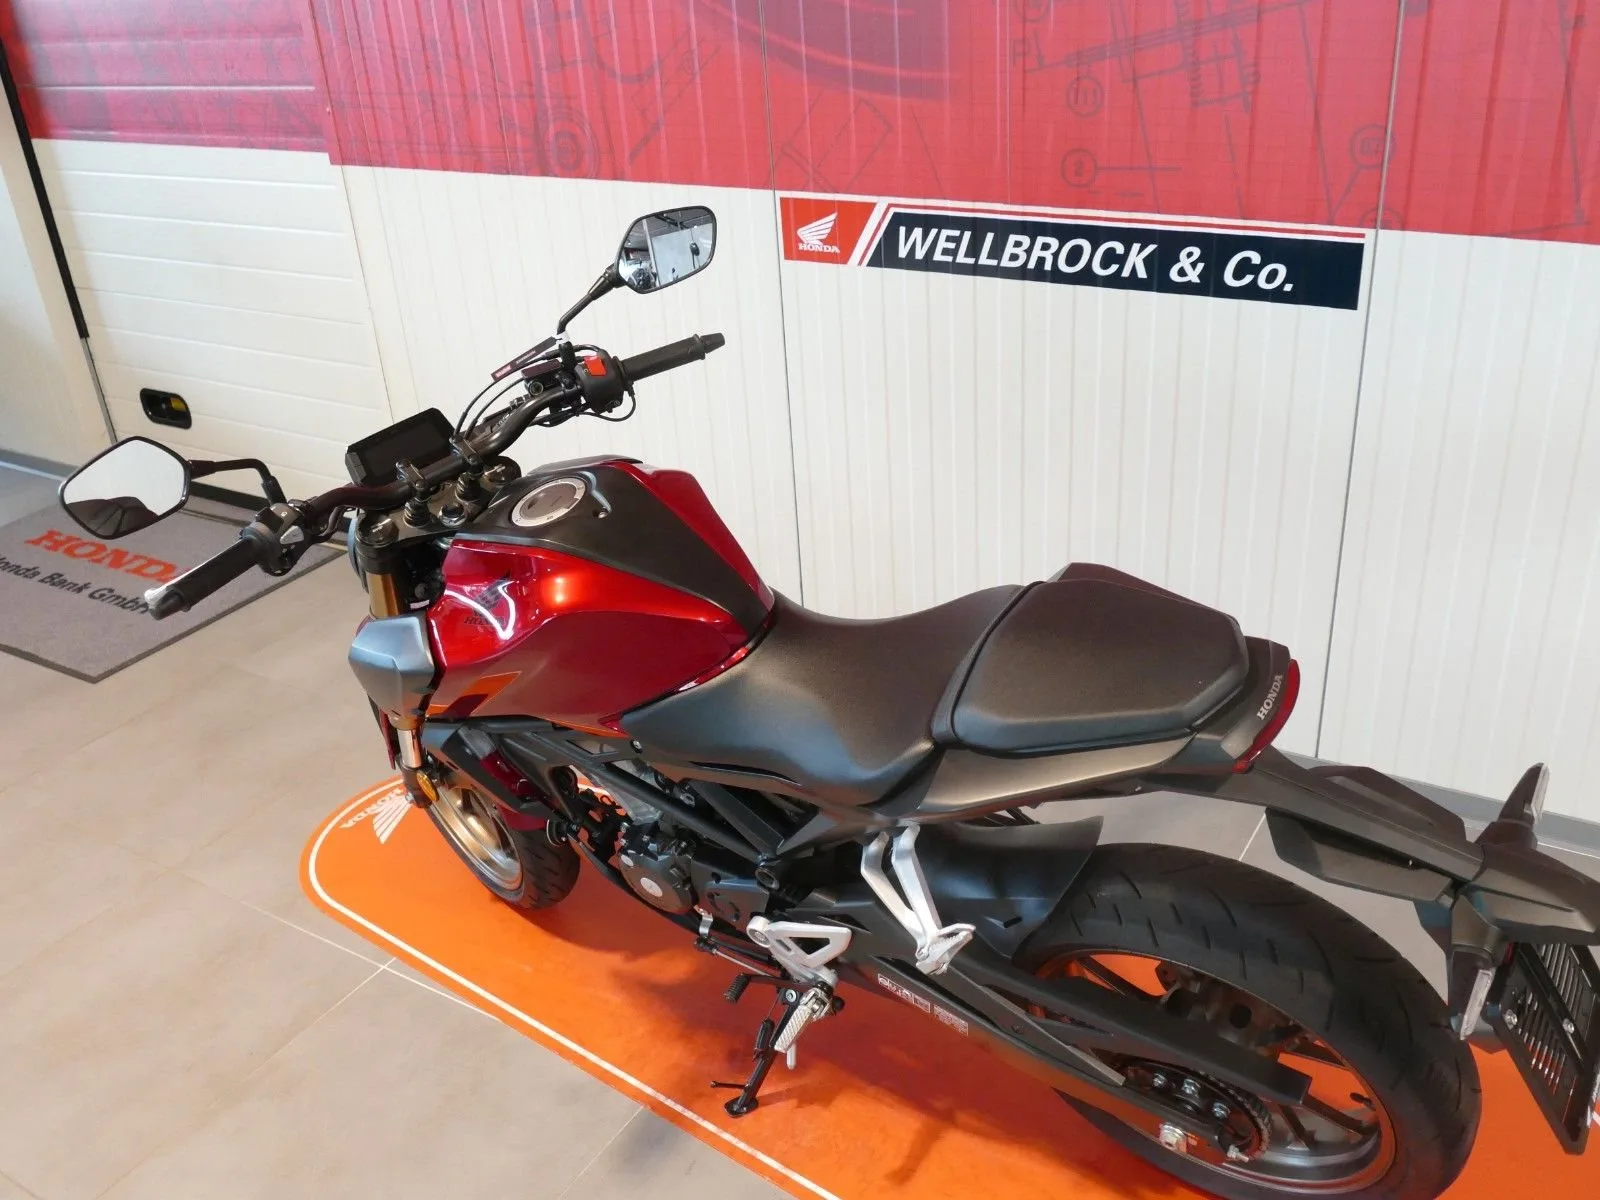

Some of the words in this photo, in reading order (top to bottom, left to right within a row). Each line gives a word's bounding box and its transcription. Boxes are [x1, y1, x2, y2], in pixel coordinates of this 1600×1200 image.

[798, 242, 841, 254] HONDA
[898, 225, 1158, 279] WELLBROCK
[1168, 246, 1205, 284] &
[1223, 250, 1294, 292] Co.
[24, 528, 191, 584] HOND
[38, 572, 92, 594] Bank
[1256, 673, 1285, 721] HONDA
